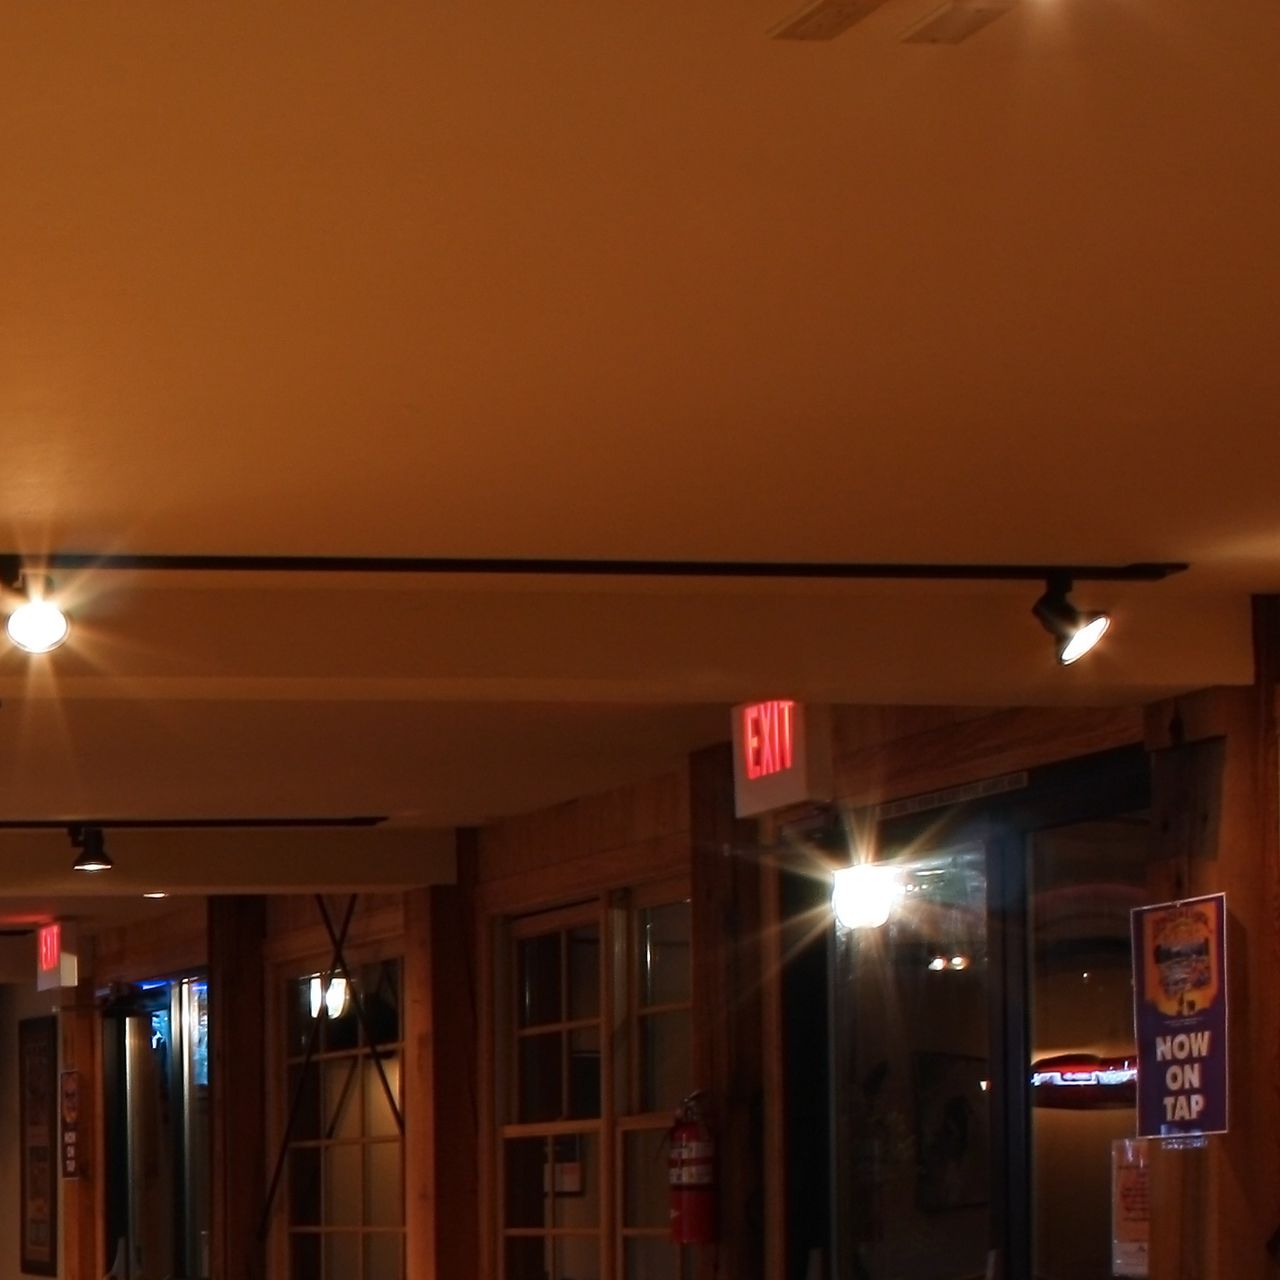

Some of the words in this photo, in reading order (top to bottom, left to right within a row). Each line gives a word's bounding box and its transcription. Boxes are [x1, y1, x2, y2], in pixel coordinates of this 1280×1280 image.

[744, 701, 794, 780] EXIT
[1155, 1031, 1211, 1062] NOW
[1165, 1063, 1202, 1090] ON
[1163, 1095, 1205, 1122] TAP
